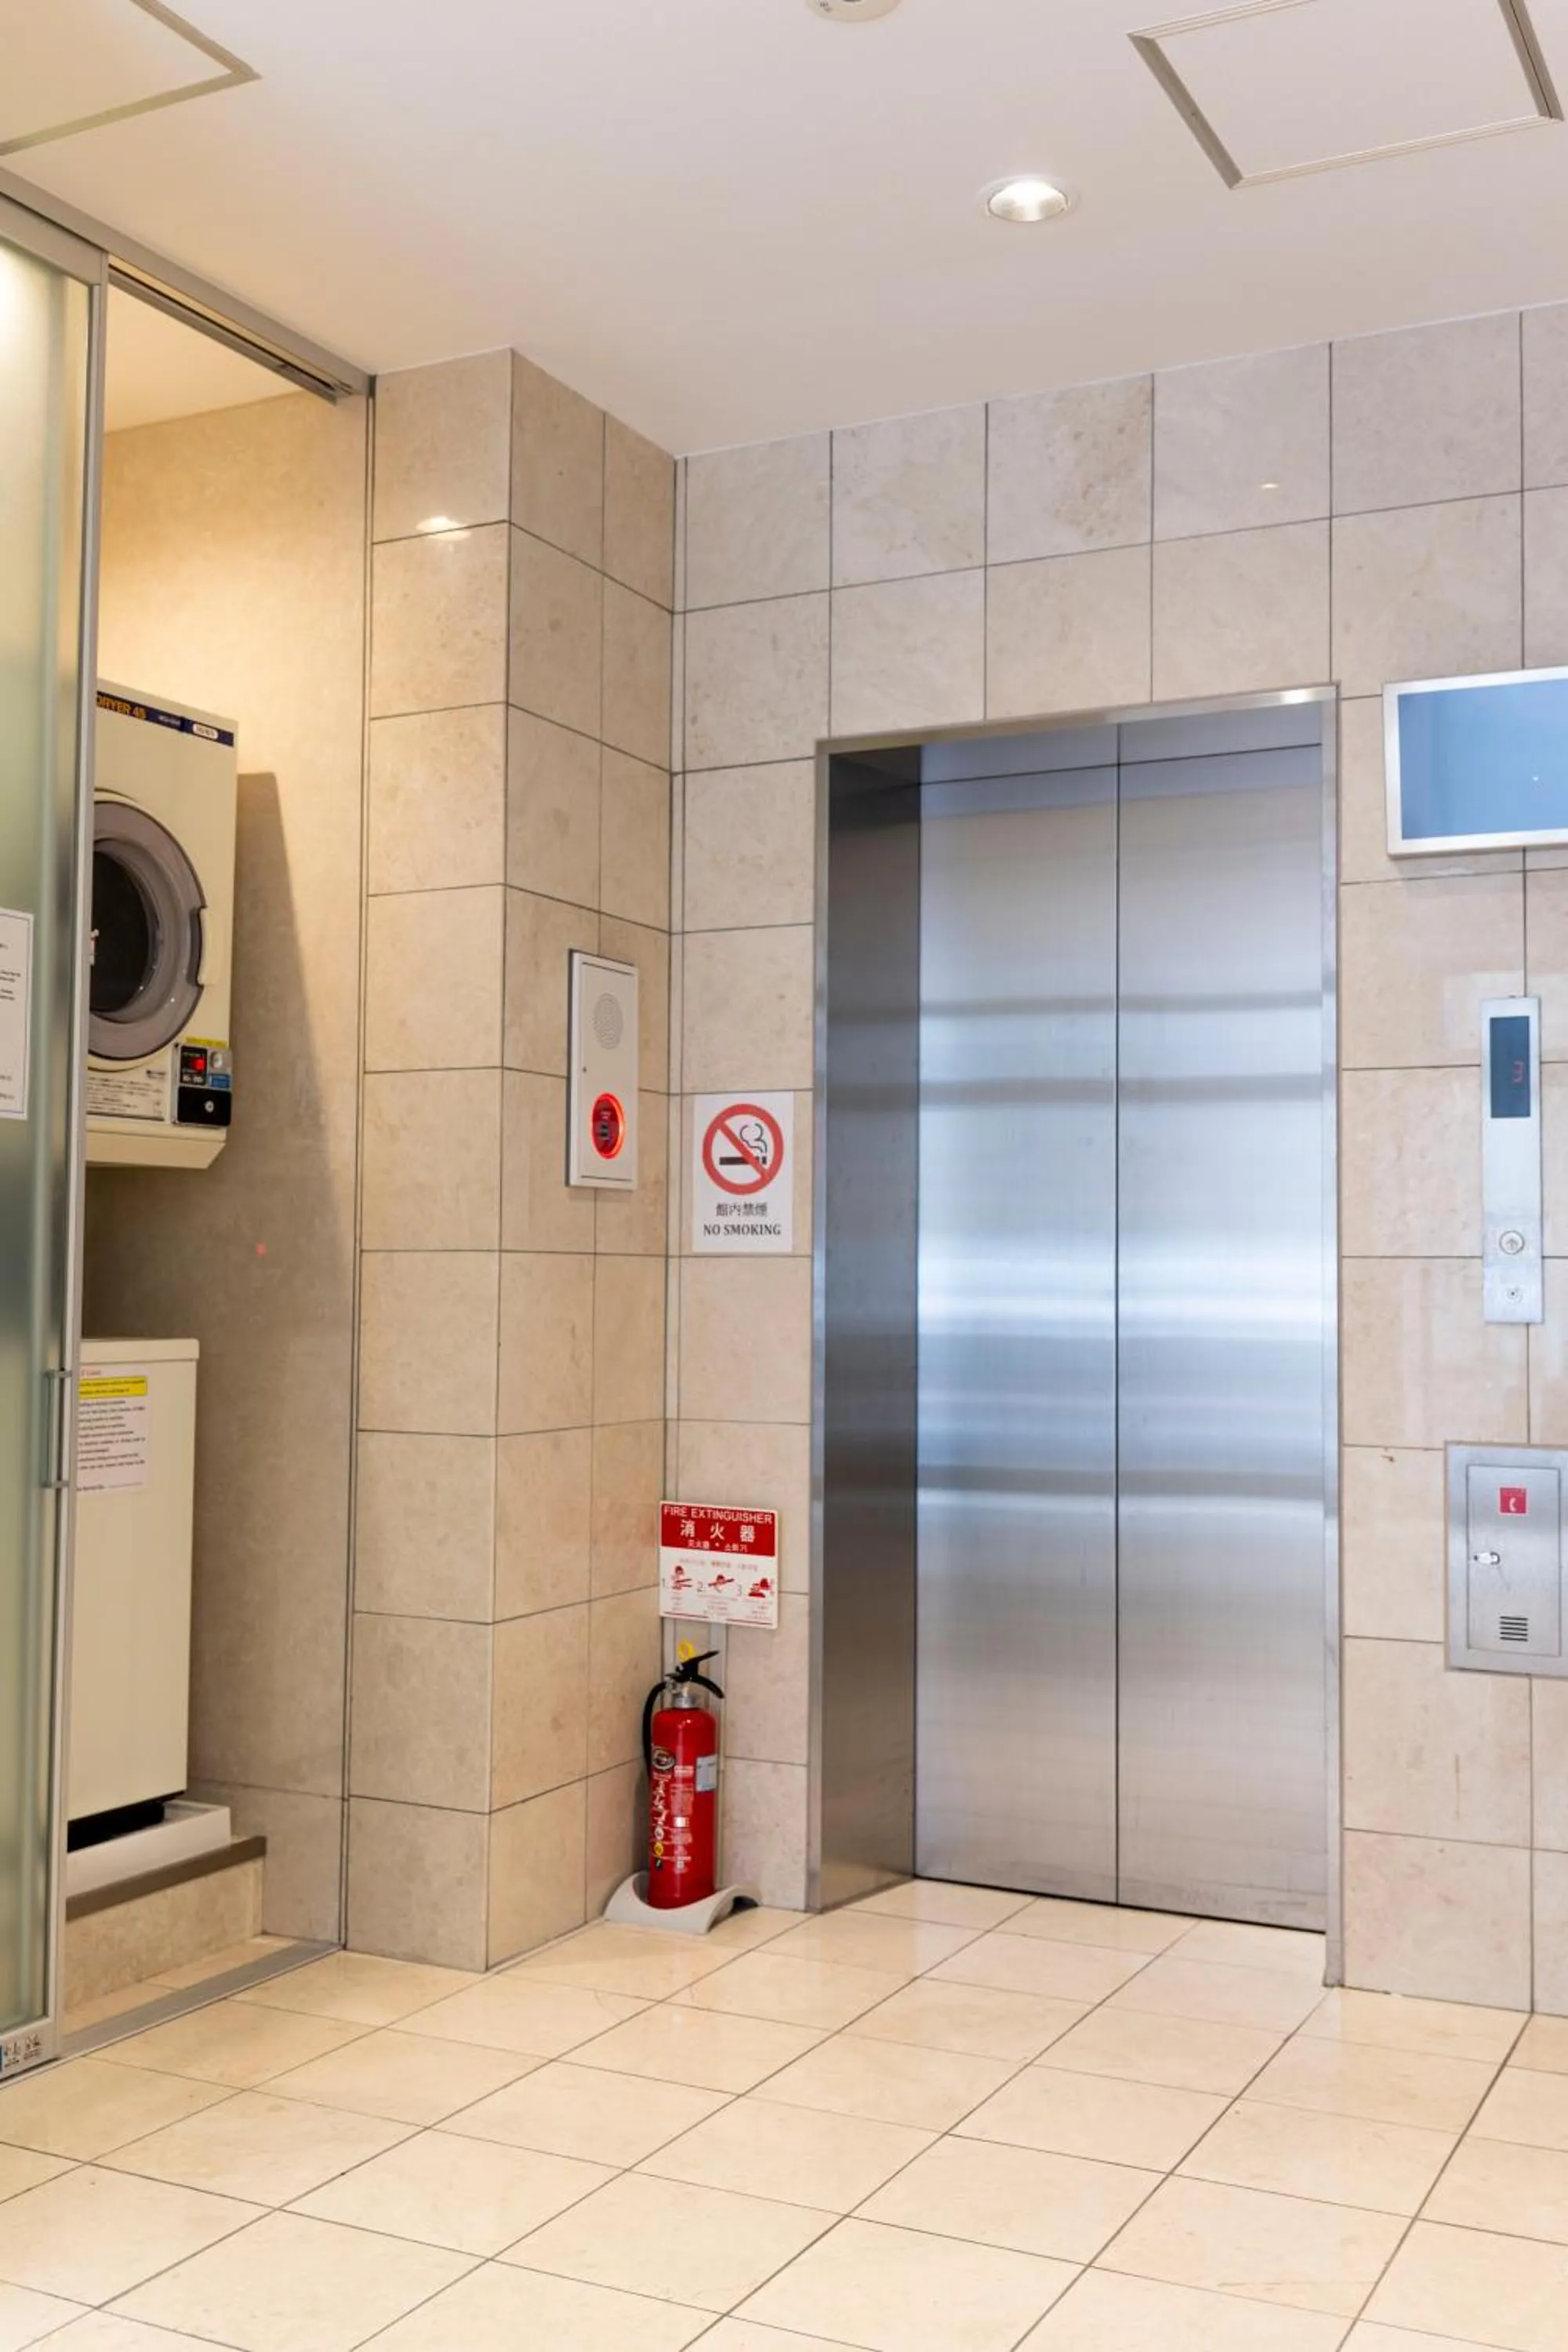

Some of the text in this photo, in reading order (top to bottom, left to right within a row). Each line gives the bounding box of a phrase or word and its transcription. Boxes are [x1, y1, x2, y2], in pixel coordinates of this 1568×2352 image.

[1513, 1060, 1524, 1083] 3
[716, 1201, 768, 1217] 館内禁煙
[703, 1223, 782, 1236] NO SMOKING
[663, 1505, 773, 1525] FIRE EXTINGUISHER
[680, 1519, 755, 1543] 消火器
